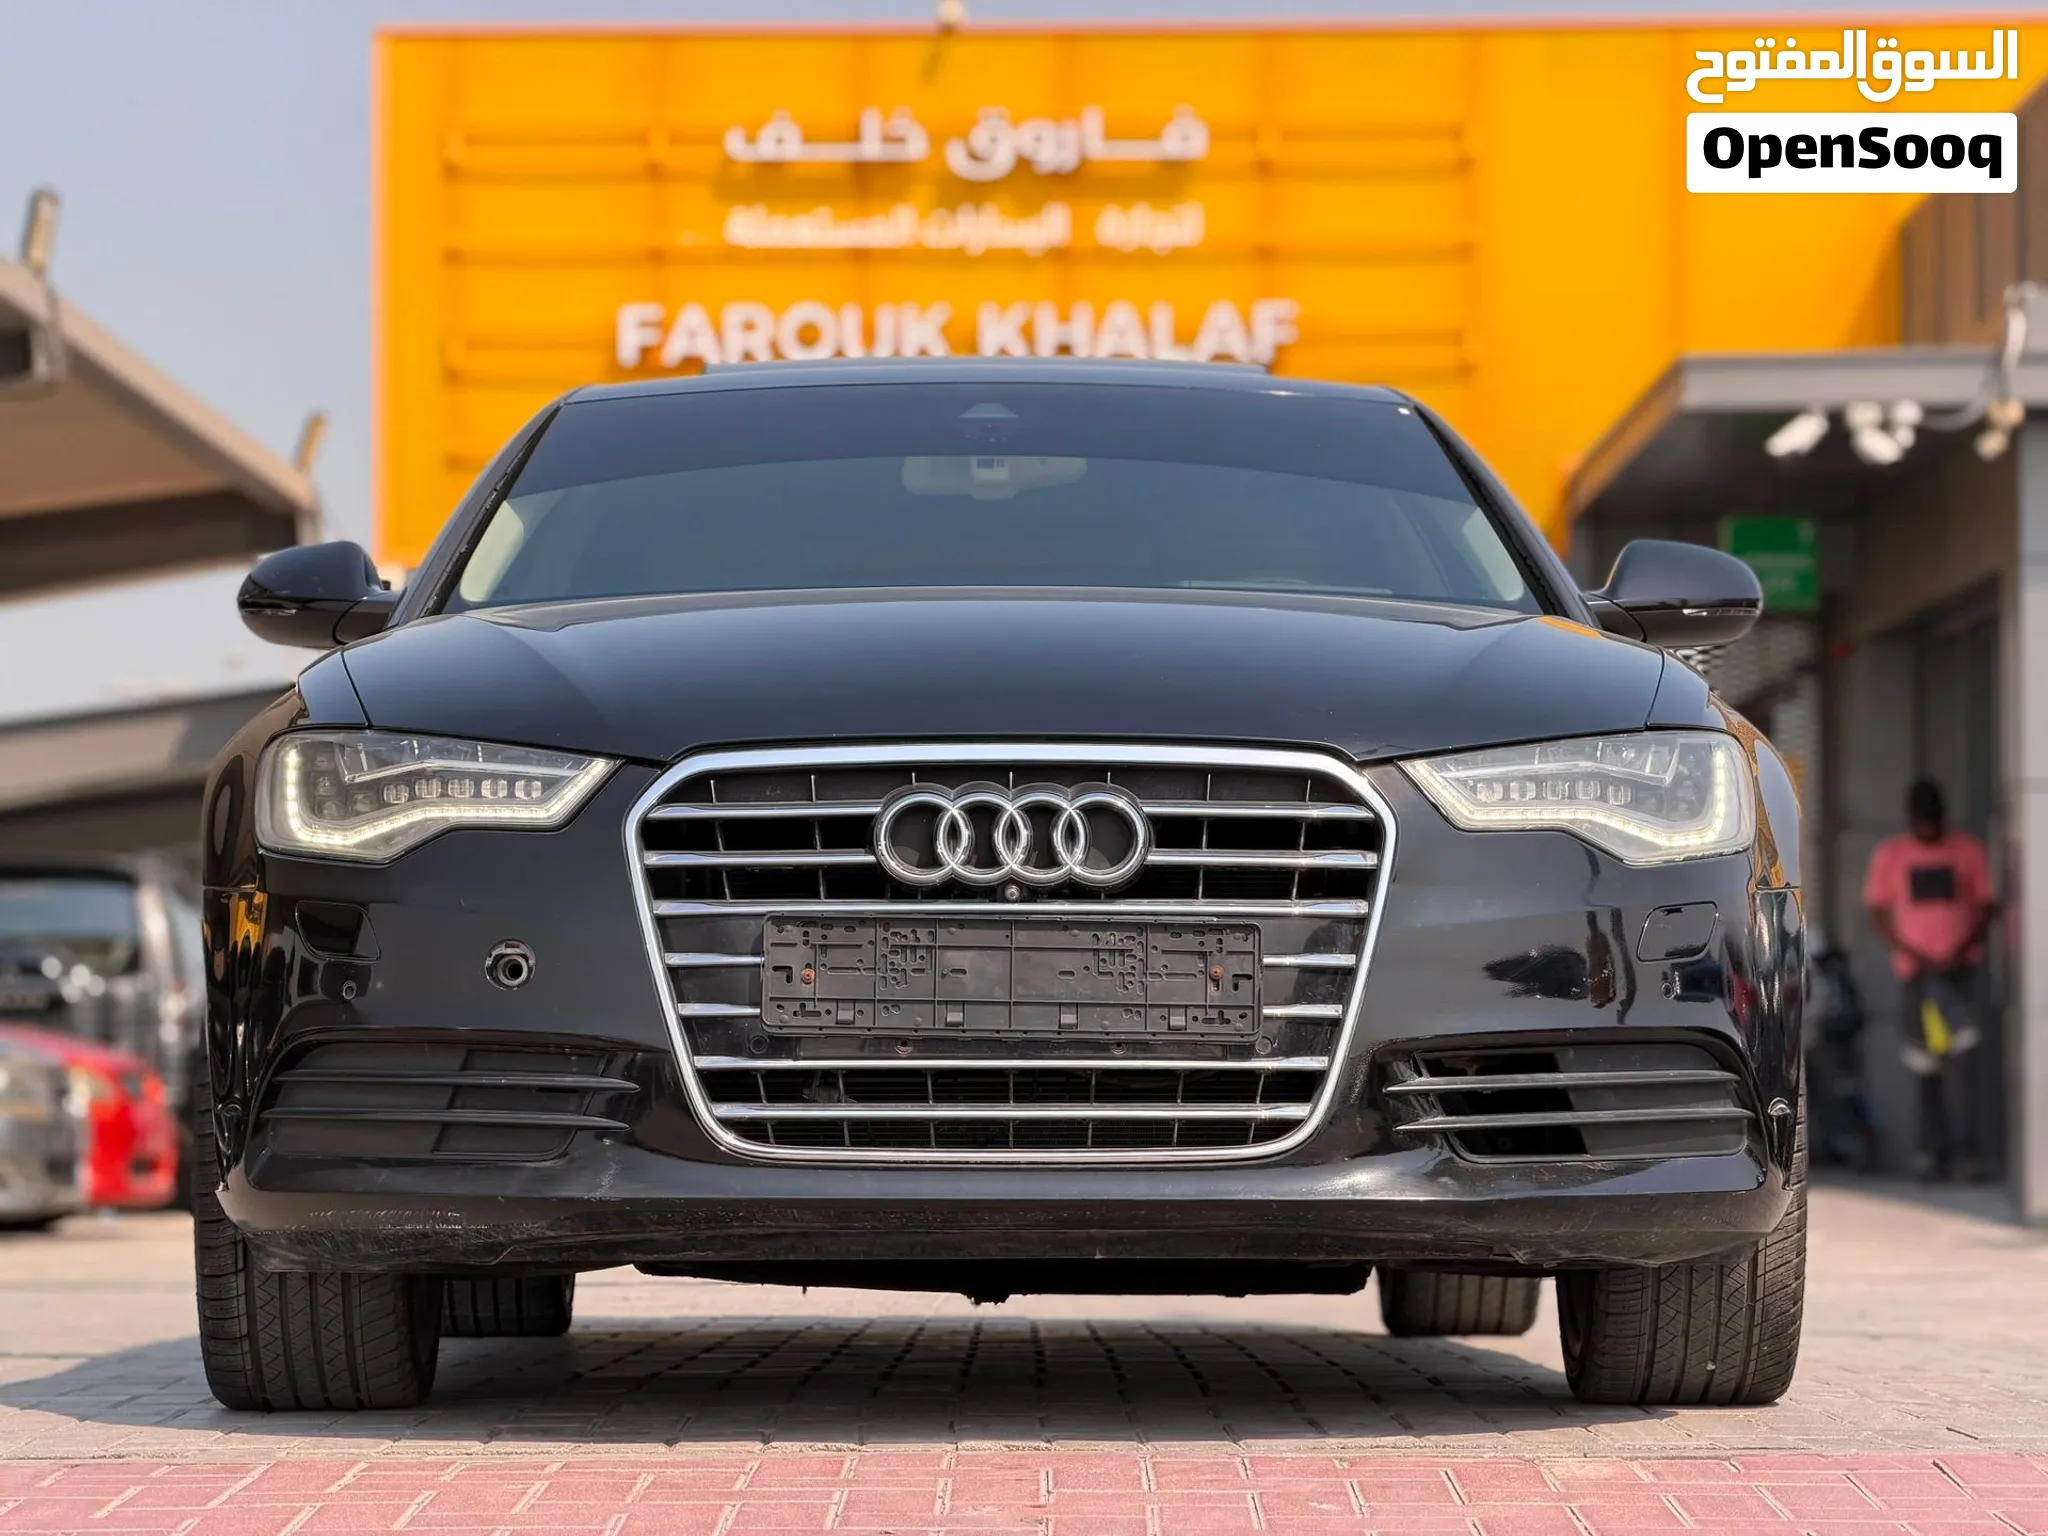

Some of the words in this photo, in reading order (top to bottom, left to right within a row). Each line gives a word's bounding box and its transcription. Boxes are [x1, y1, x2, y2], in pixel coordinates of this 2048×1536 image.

[723, 105, 930, 163] خلف
[944, 105, 1210, 182] فاروق
[615, 301, 952, 369] FAROUK
[976, 297, 1300, 365] KHALAF
